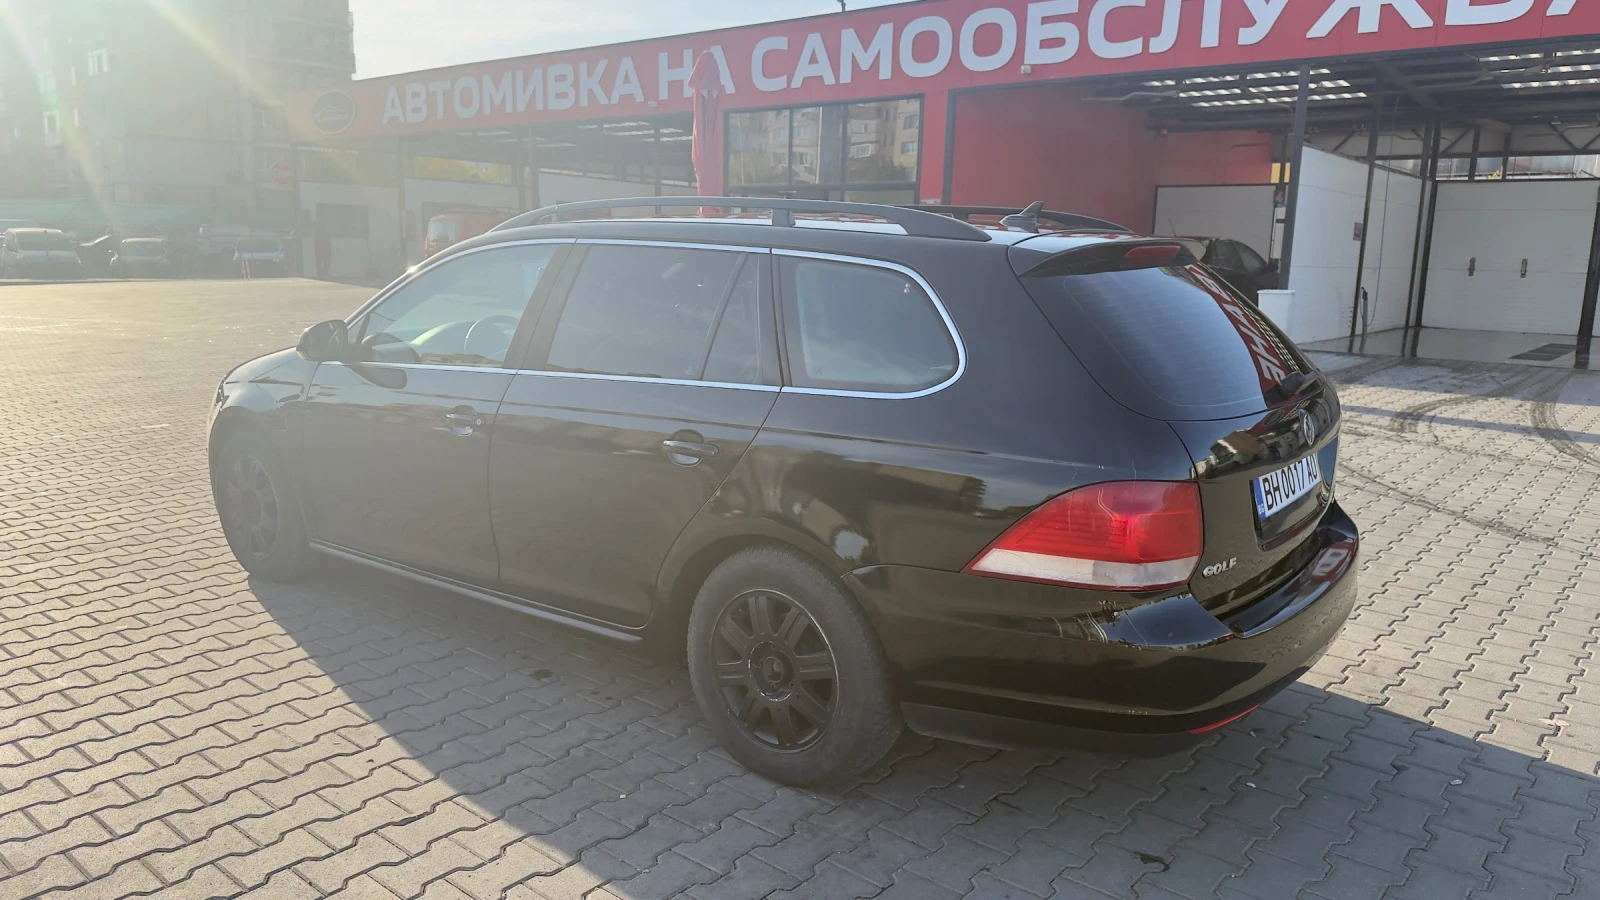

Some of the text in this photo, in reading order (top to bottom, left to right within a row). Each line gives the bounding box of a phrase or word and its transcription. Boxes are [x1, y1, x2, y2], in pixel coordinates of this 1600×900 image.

[382, 57, 644, 125] АВТОМИВКА
[751, 0, 1577, 92] САМООБСЛУ
[1202, 556, 1237, 577] GOLF
